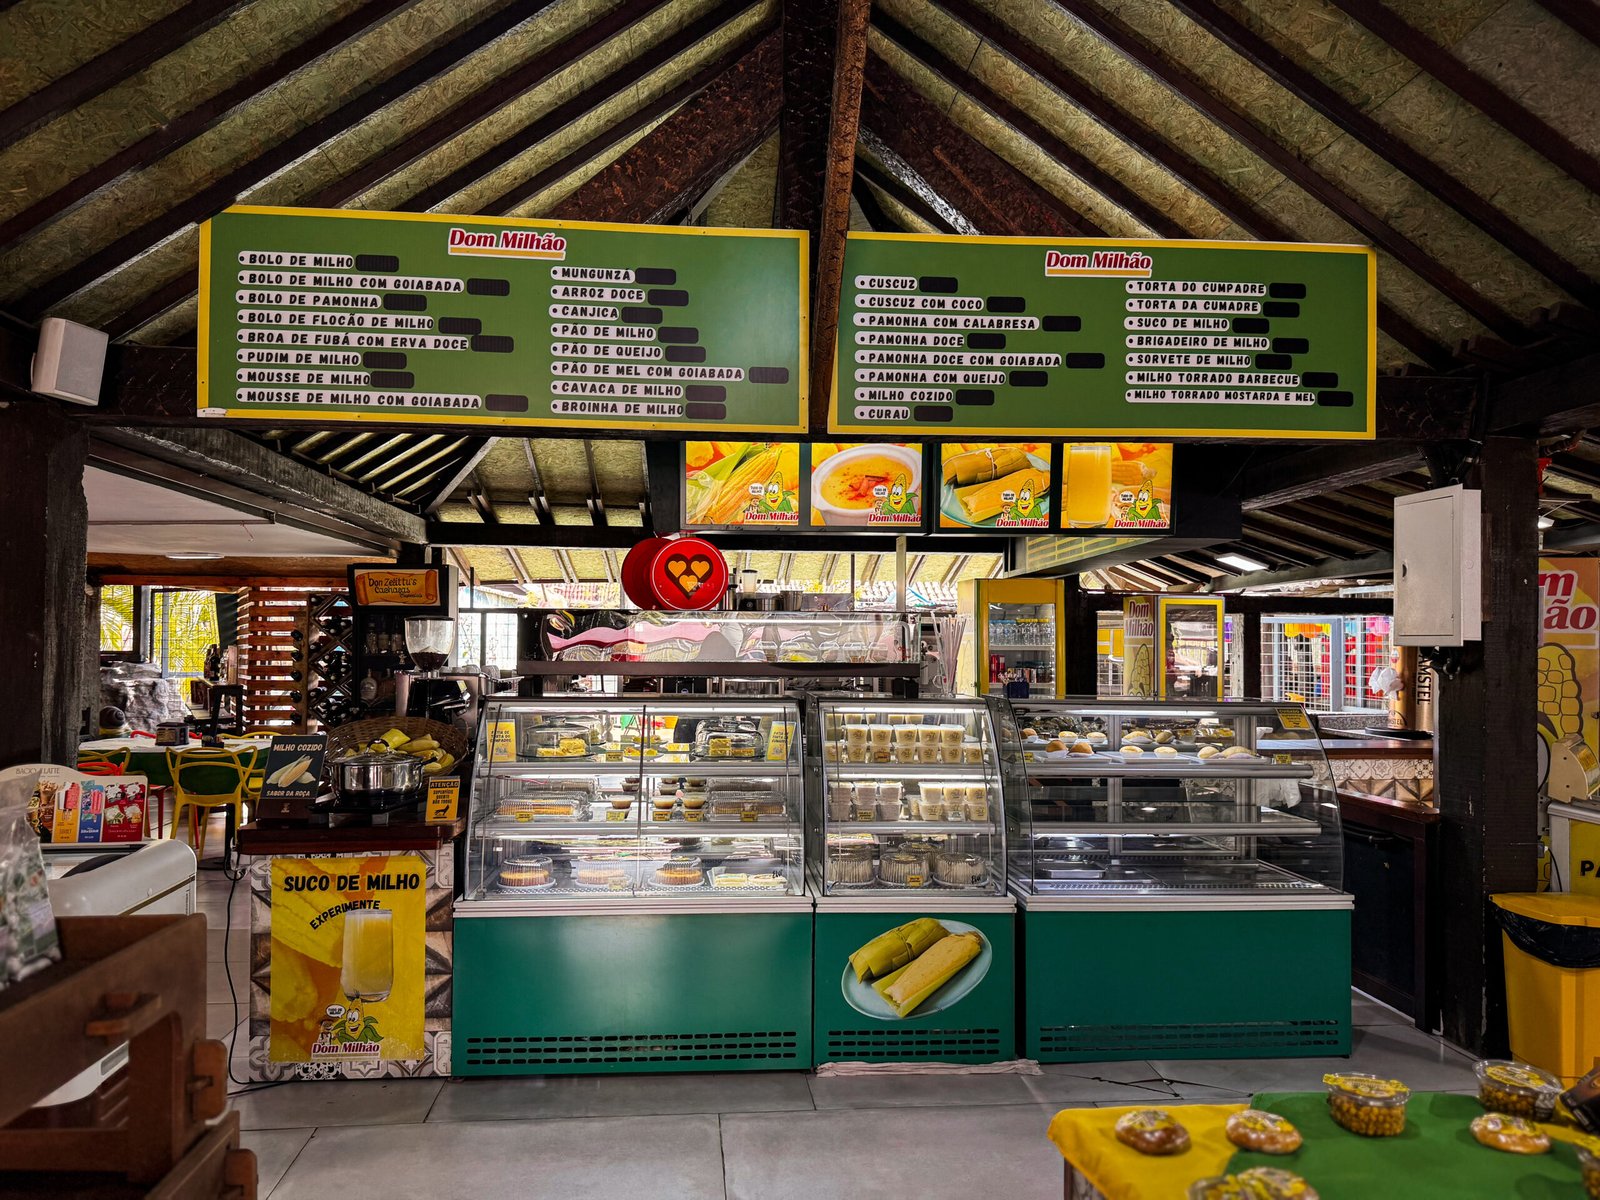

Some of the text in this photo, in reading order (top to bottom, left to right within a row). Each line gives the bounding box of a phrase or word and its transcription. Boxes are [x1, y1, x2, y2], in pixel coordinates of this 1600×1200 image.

[450, 229, 565, 250] Dom Milhão
[249, 254, 353, 267] BOLO DE MILHO
[1047, 252, 1151, 269] Dom Milhão
[561, 267, 630, 280] MUNGUNZÁ
[249, 274, 461, 291] BOLO DE MILHO COM GOIABADA
[869, 278, 915, 289] CUSCUZ
[1137, 282, 1265, 294] TORTA DO CUMPADRE
[249, 293, 378, 307] BOLO DE PAMONHA
[562, 287, 643, 300] ARROZ DOCE
[869, 297, 982, 309] CUSCUZ COM COCO
[1137, 300, 1258, 312] TORTA DA CUMADRE
[561, 306, 618, 318] CANJICA
[248, 313, 434, 329] BOLO DE FLOCÃO DE MILHO
[869, 316, 1035, 329] PAMONHA COM CALABRESA
[1137, 318, 1227, 328] SUCO DE MILHO
[561, 323, 654, 338] PÃO DE MILHO
[248, 332, 468, 349] BROA DE FUBÁ COM ERVA DOCE
[869, 334, 964, 346] PAMONHA DOCE
[1137, 336, 1268, 348] BRIGADEIRO DE MILHO
[561, 342, 661, 358] PÃO DE QUEIJO
[247, 352, 359, 365] PUDIM DE MILHO
[869, 353, 1061, 366] PAMONHA DOCE COM GOIABADA
[1137, 354, 1250, 365] SORVETE DE MILHO
[561, 361, 742, 379] PÃO DE MEL COM GOIABADA
[247, 372, 370, 385] MOUSSE DE MILHO
[869, 372, 1005, 384] PAMONHA COM QUEIJO
[1137, 372, 1299, 385] MILHO TORRADO BARBECUE
[562, 383, 681, 396] CAVACA DE MILHO
[869, 390, 952, 402] MILHO COZIDO
[1135, 390, 1315, 402] MILHO TORRADO MOSTARDA E MEL
[247, 391, 479, 408] MOUSSE DE MILHO COM GOIABADA
[562, 402, 683, 415] BROINHA DE MILHO
[868, 409, 908, 419] CURAU
[745, 512, 798, 520] Dom Milhão
[869, 514, 921, 522] Dom Milhão
[997, 519, 1048, 527] Dom Milhão
[1114, 520, 1166, 528] Dom Milhão
[1129, 600, 1149, 618] Dom
[273, 743, 323, 752] MILHO COZIDO
[1581, 860, 1600, 878] P
[284, 874, 420, 891] SUCO DE MILHO
[309, 900, 381, 930] EXPERIMENTE
[313, 1043, 380, 1053] Dom Milhão
